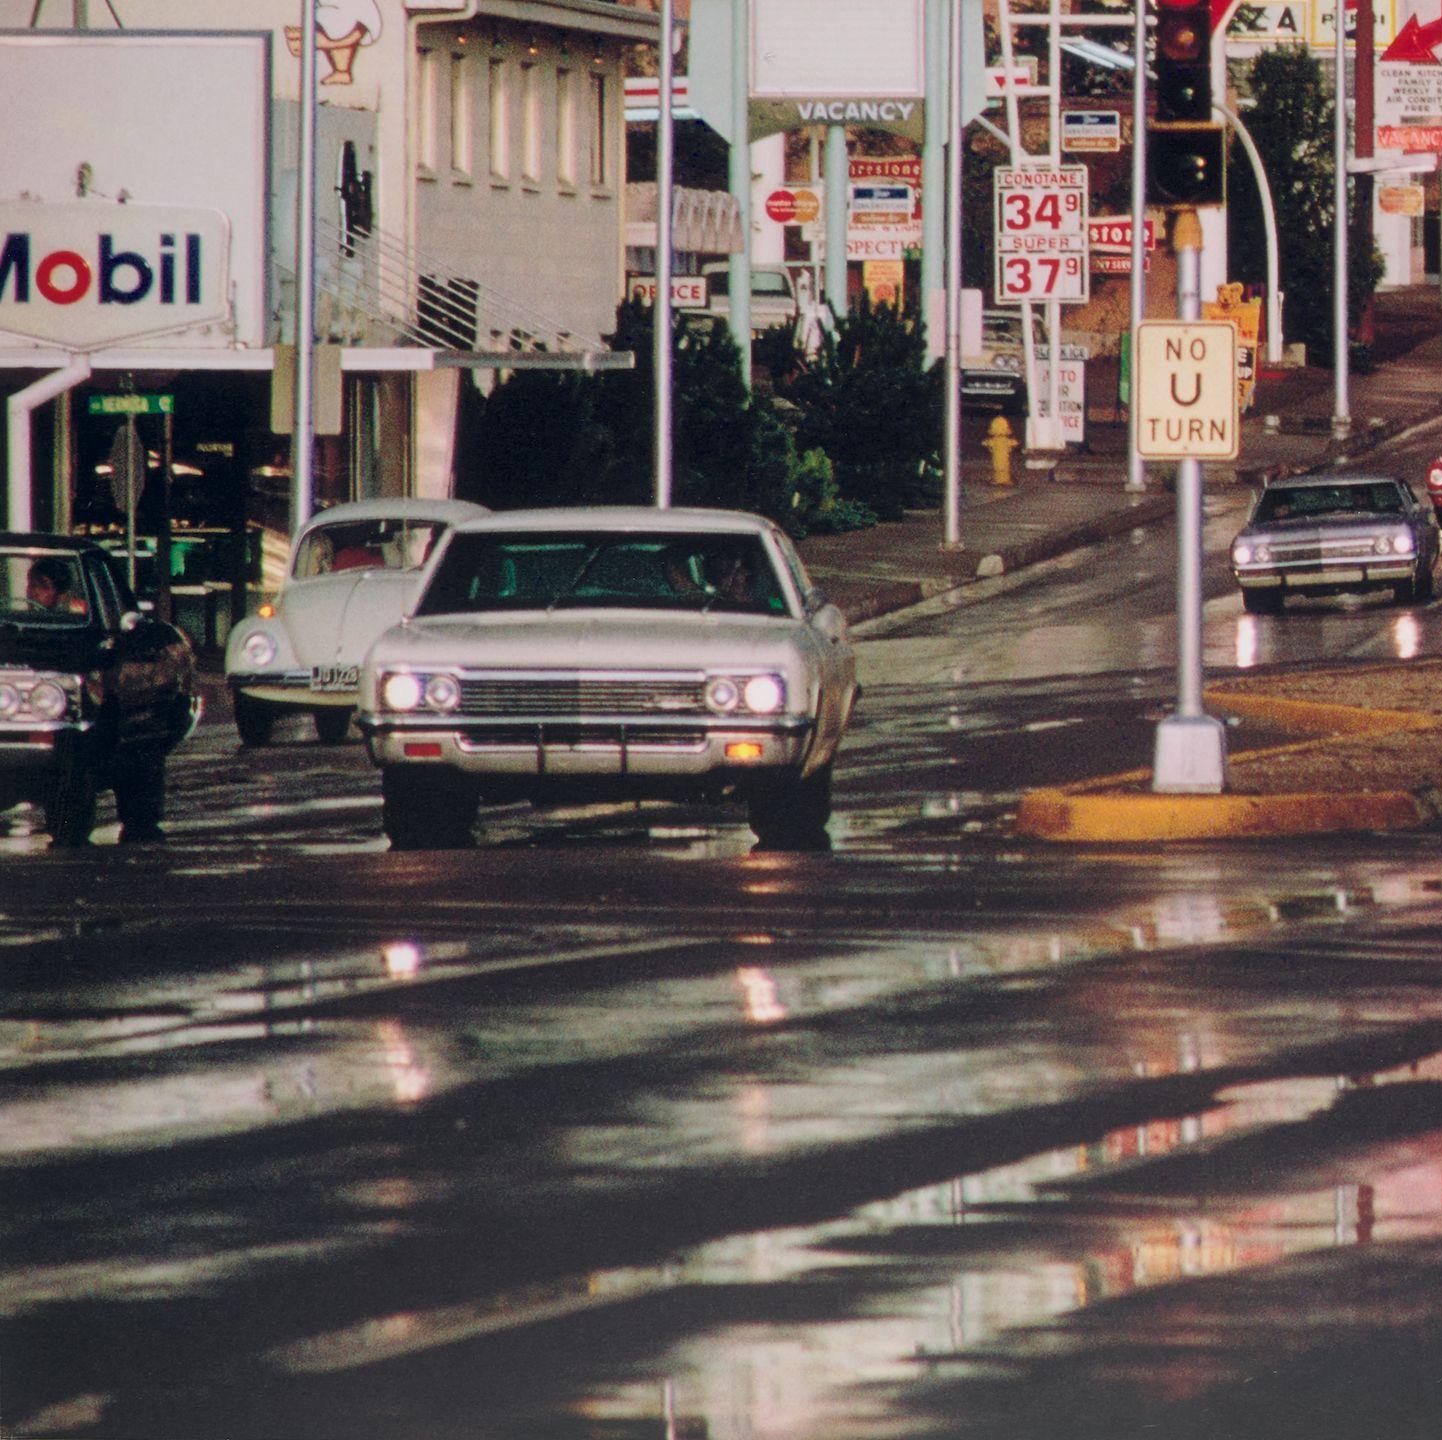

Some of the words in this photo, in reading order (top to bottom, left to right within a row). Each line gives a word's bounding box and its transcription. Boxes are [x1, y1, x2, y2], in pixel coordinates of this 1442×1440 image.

[1321, 13, 1386, 25] PPI
[1380, 69, 1412, 78] CLEAN
[797, 101, 915, 121] VACANCY
[1004, 173, 1077, 186] CONOTANE
[1089, 222, 1151, 244] stoe
[1013, 236, 1071, 250] SUPER
[0, 232, 202, 306] Mobil
[633, 283, 701, 301] OFCE
[1165, 336, 1208, 361] NO
[1041, 369, 1077, 383] ATO
[1170, 372, 1202, 406] U
[1147, 418, 1227, 442] TURN
